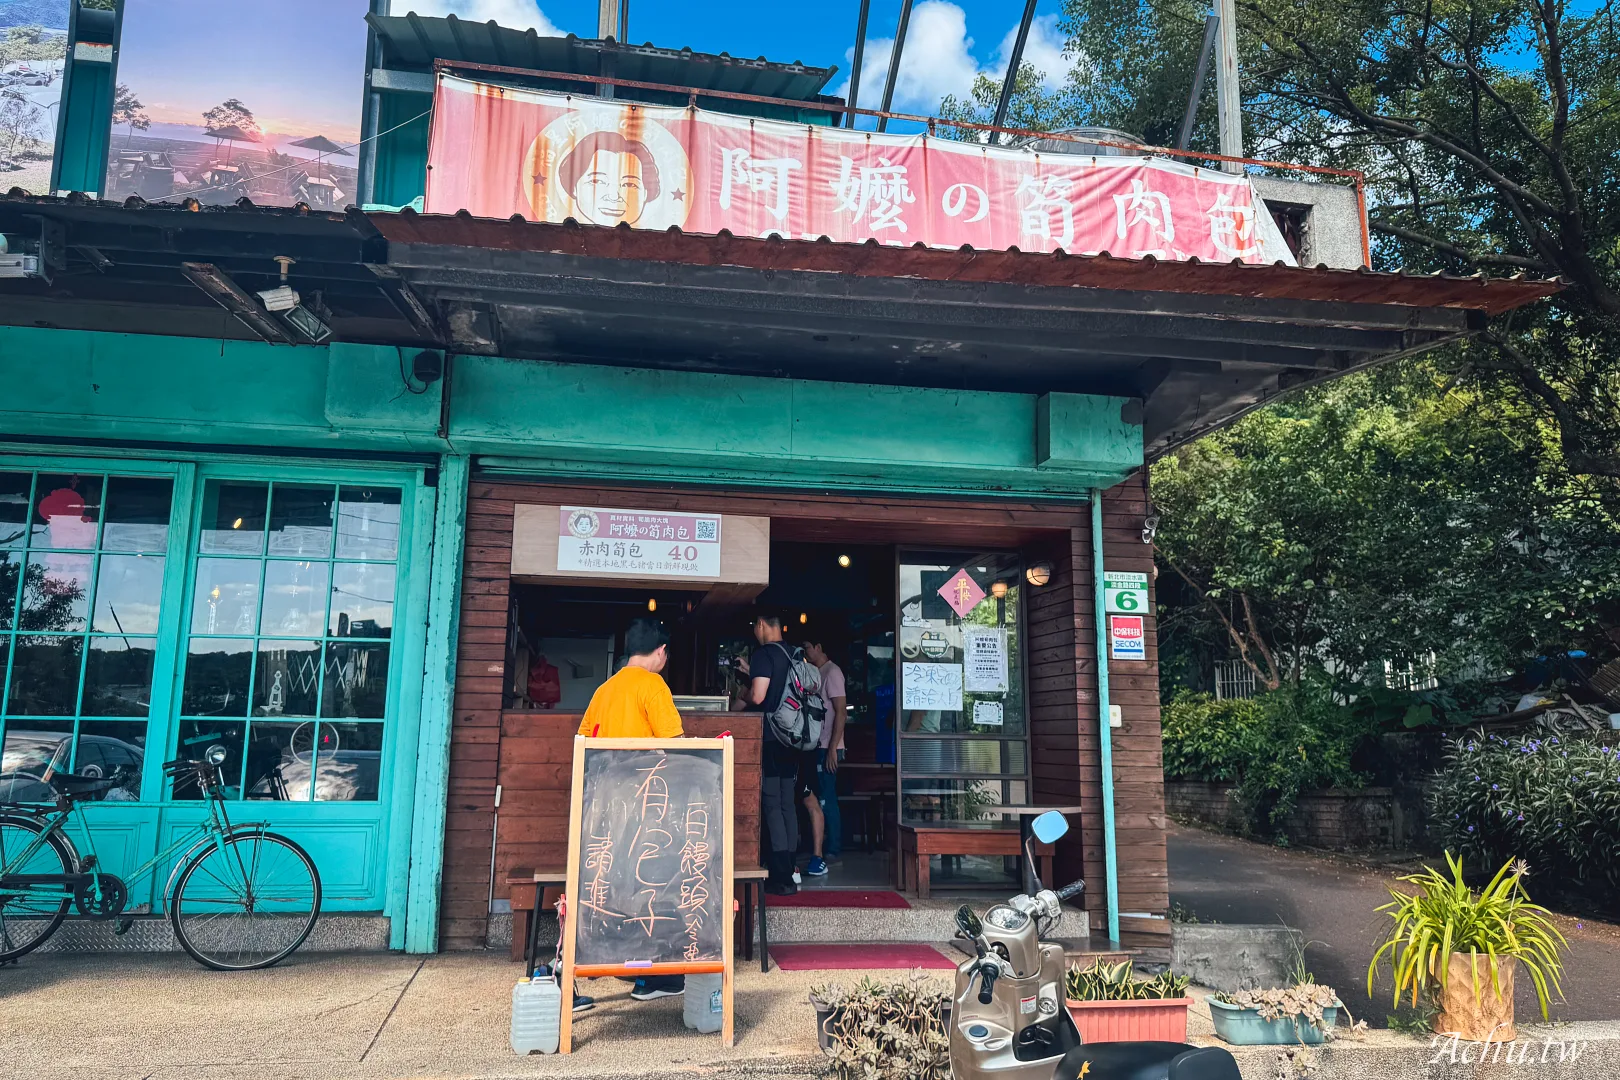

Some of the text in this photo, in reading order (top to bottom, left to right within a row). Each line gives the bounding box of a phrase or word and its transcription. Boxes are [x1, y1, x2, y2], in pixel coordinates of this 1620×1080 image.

[718, 146, 1259, 258] 阿嬤の筍肉包
[610, 523, 690, 540] 阿嬤の筍肉包
[579, 540, 698, 561] 赤肉筍包 40
[953, 578, 972, 609] 平安
[1116, 591, 1138, 610] 6
[1114, 627, 1141, 636] 中保科技
[1116, 640, 1141, 648] SECOM
[623, 759, 677, 937] 有包子
[580, 831, 626, 918] 請進
